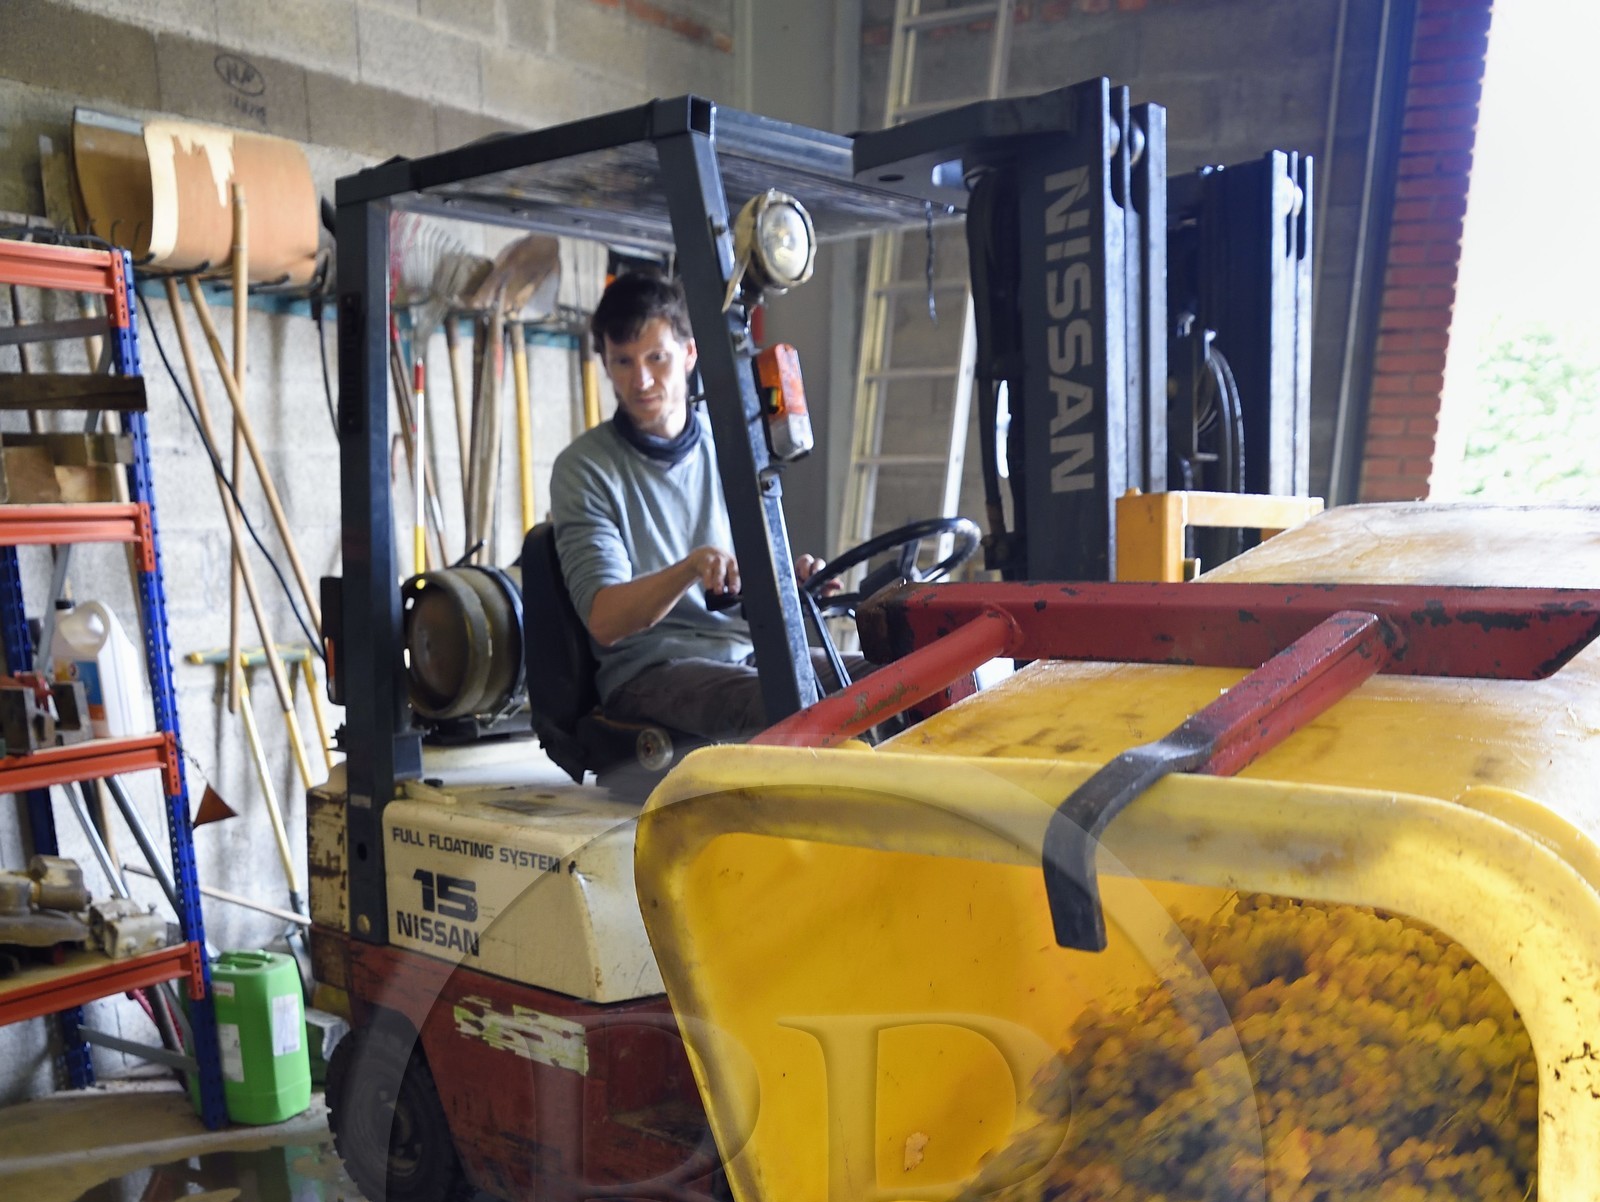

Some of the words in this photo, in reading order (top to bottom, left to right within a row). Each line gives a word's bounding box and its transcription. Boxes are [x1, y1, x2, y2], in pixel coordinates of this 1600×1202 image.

[1045, 165, 1095, 493] NISSAN
[392, 827, 425, 847] FULL
[428, 833, 494, 860] FLOATING
[499, 847, 561, 874] SYSTEM
[413, 868, 478, 923] 15
[396, 910, 480, 957] NISSAN
